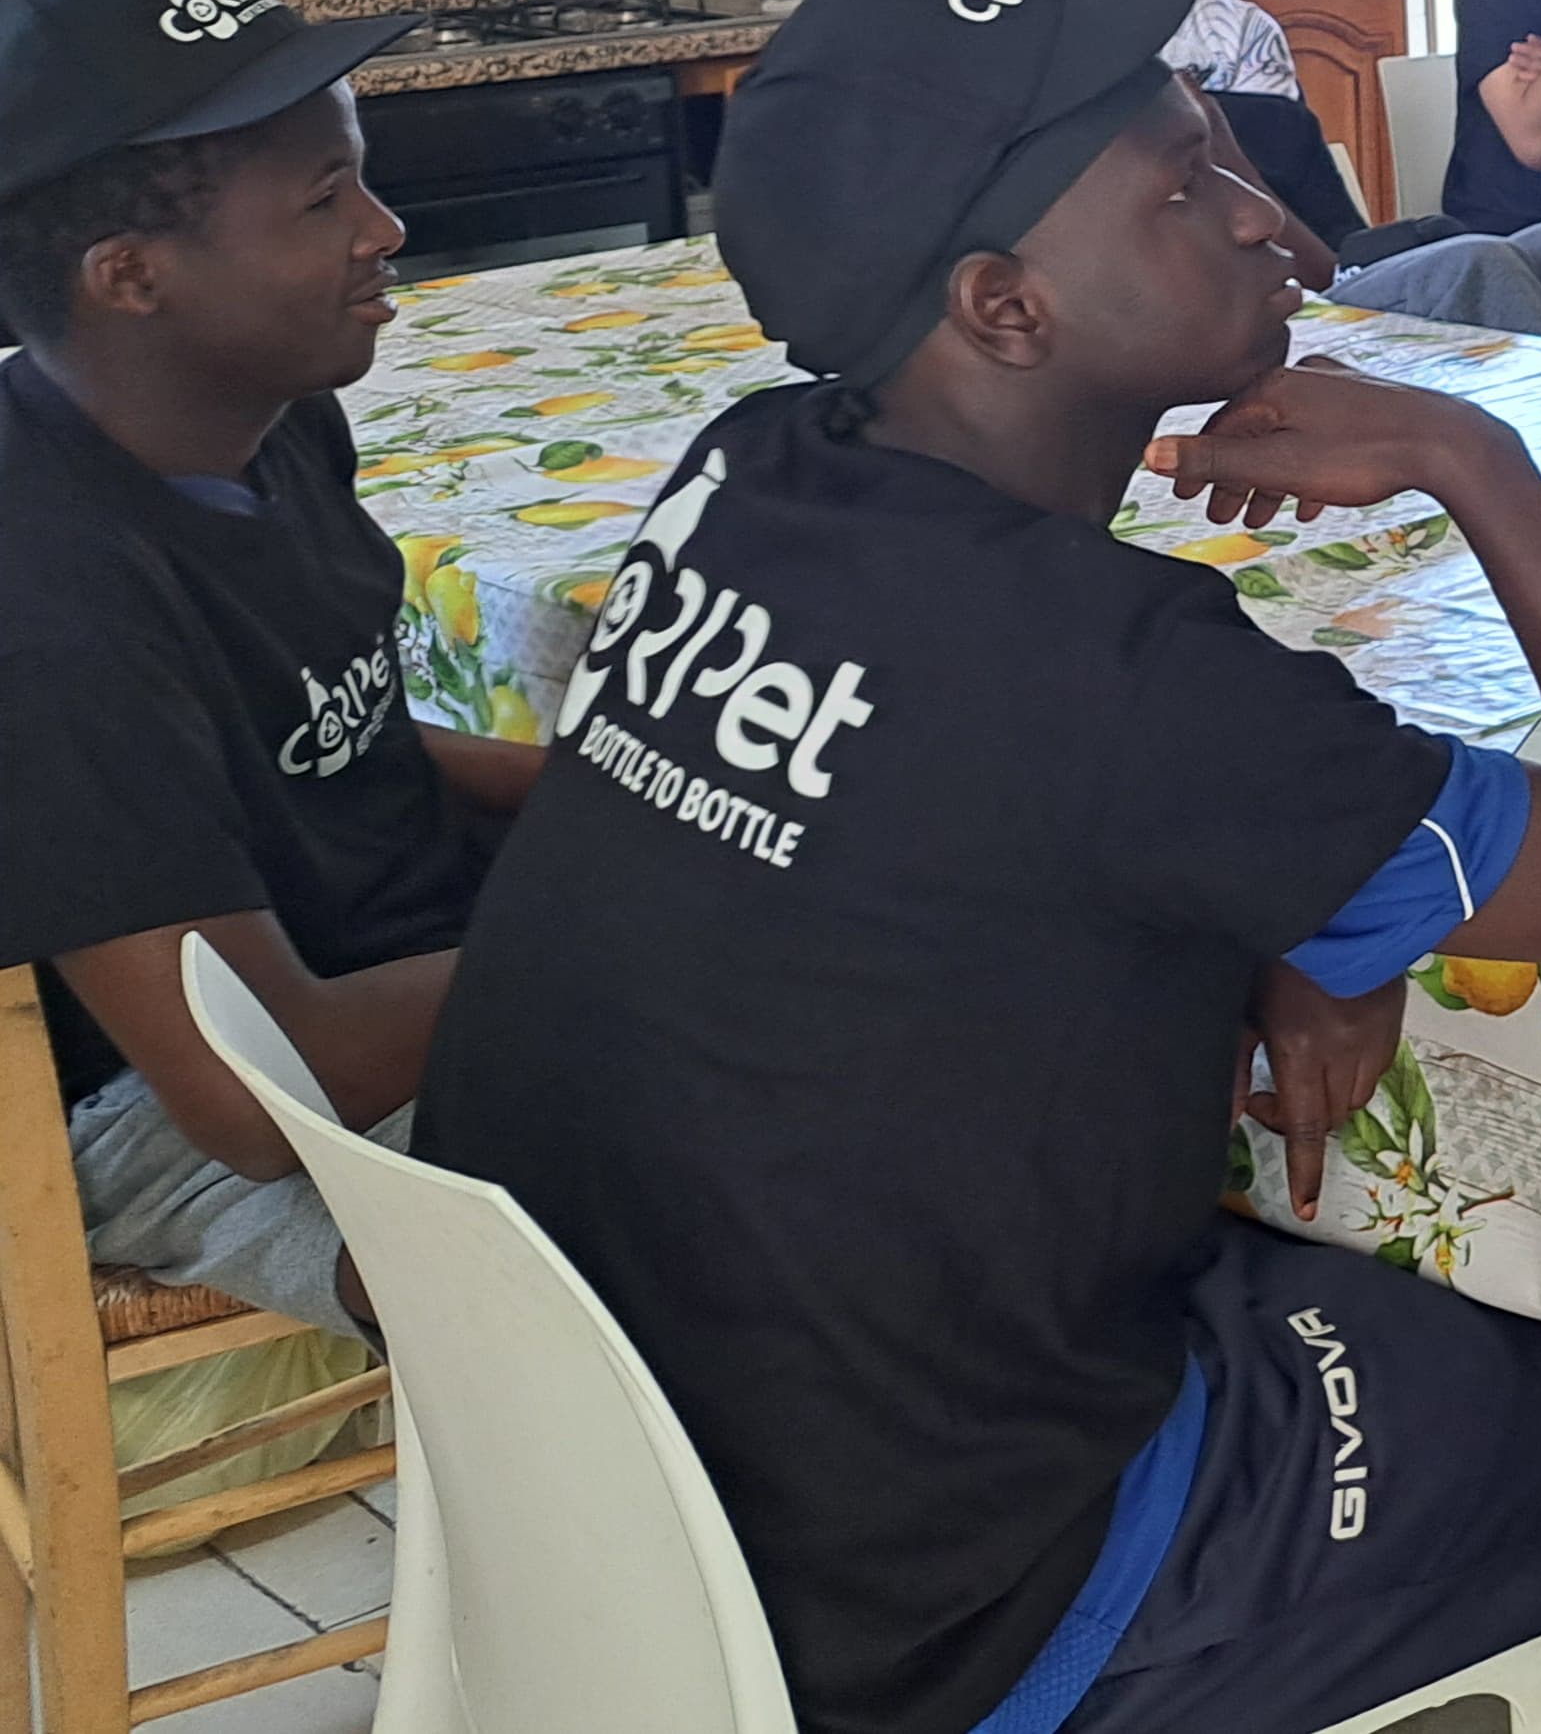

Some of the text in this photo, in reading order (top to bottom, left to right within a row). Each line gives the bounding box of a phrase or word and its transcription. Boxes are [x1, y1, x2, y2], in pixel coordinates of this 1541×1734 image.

[578, 714, 806, 868] BOTTLE TO BOTTLE
[1286, 1306, 1369, 1541] GIVOVA
